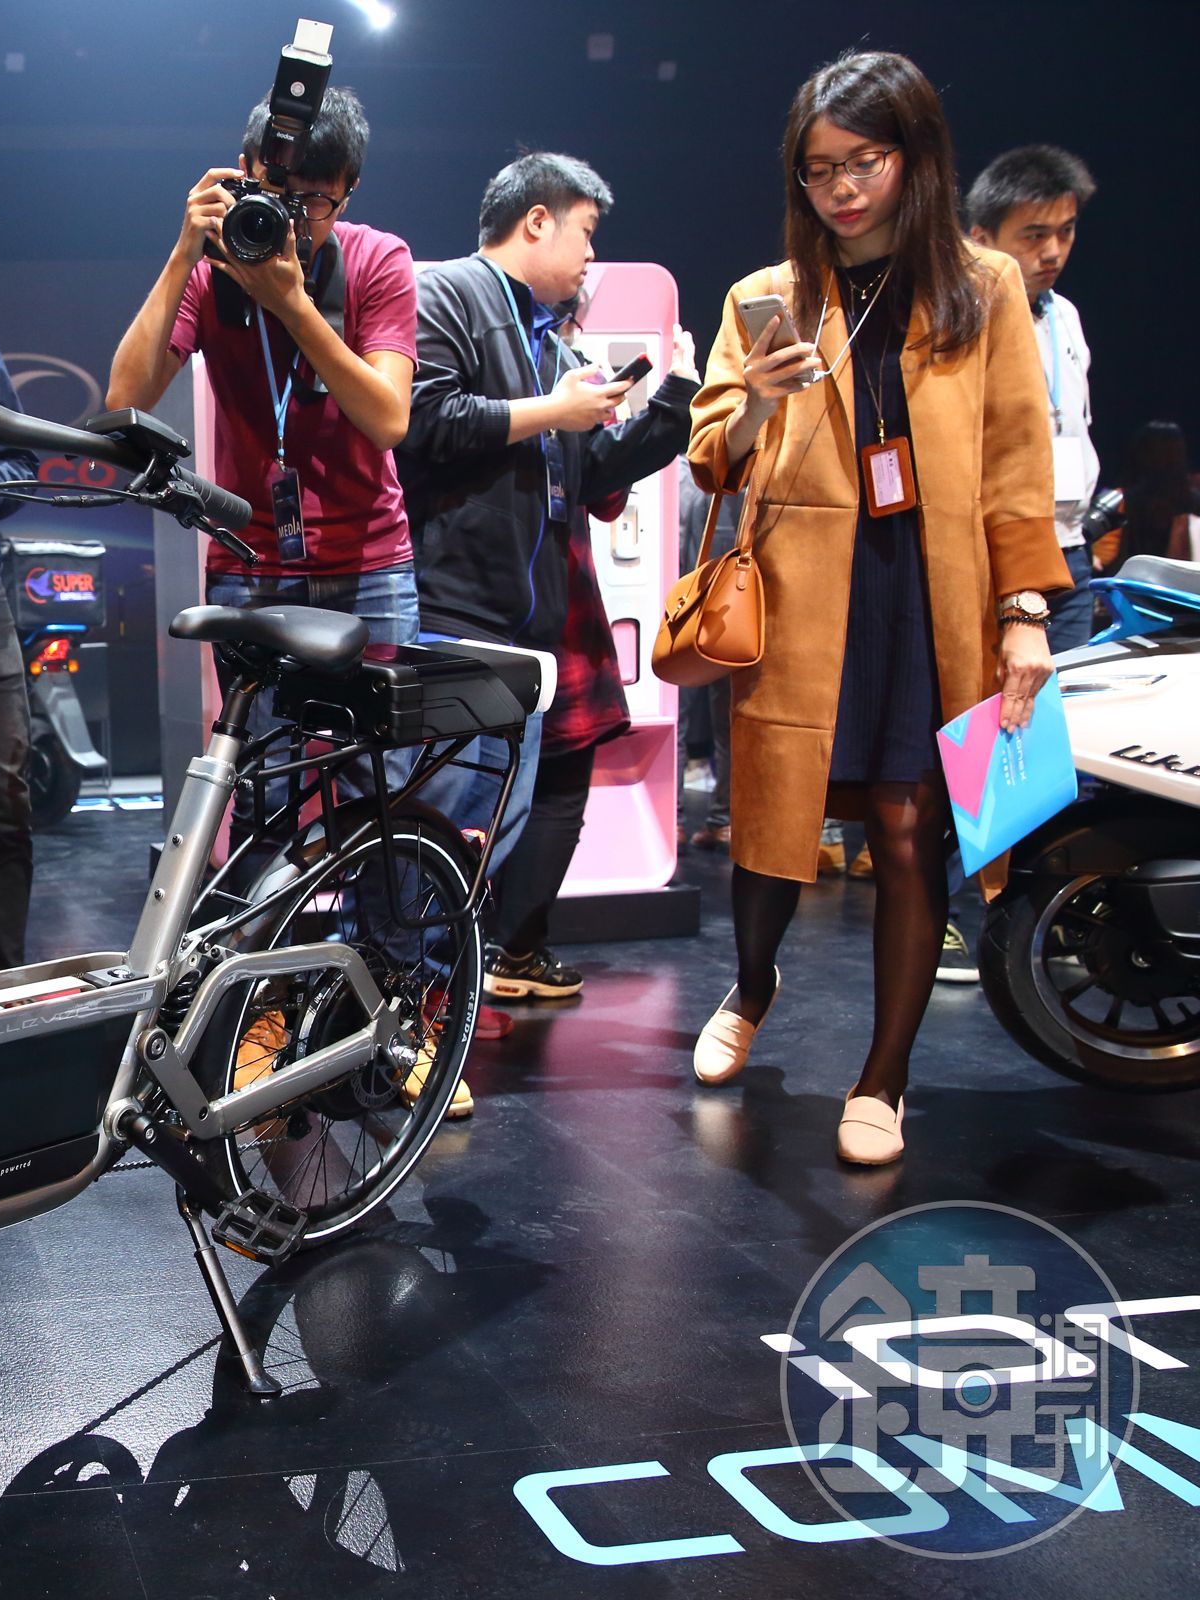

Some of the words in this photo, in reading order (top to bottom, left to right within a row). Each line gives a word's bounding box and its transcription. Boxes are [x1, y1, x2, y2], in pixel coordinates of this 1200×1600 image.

[278, 514, 302, 539] MEDIA
[52, 573, 96, 593] SUPER
[461, 991, 476, 1043] KENDA
